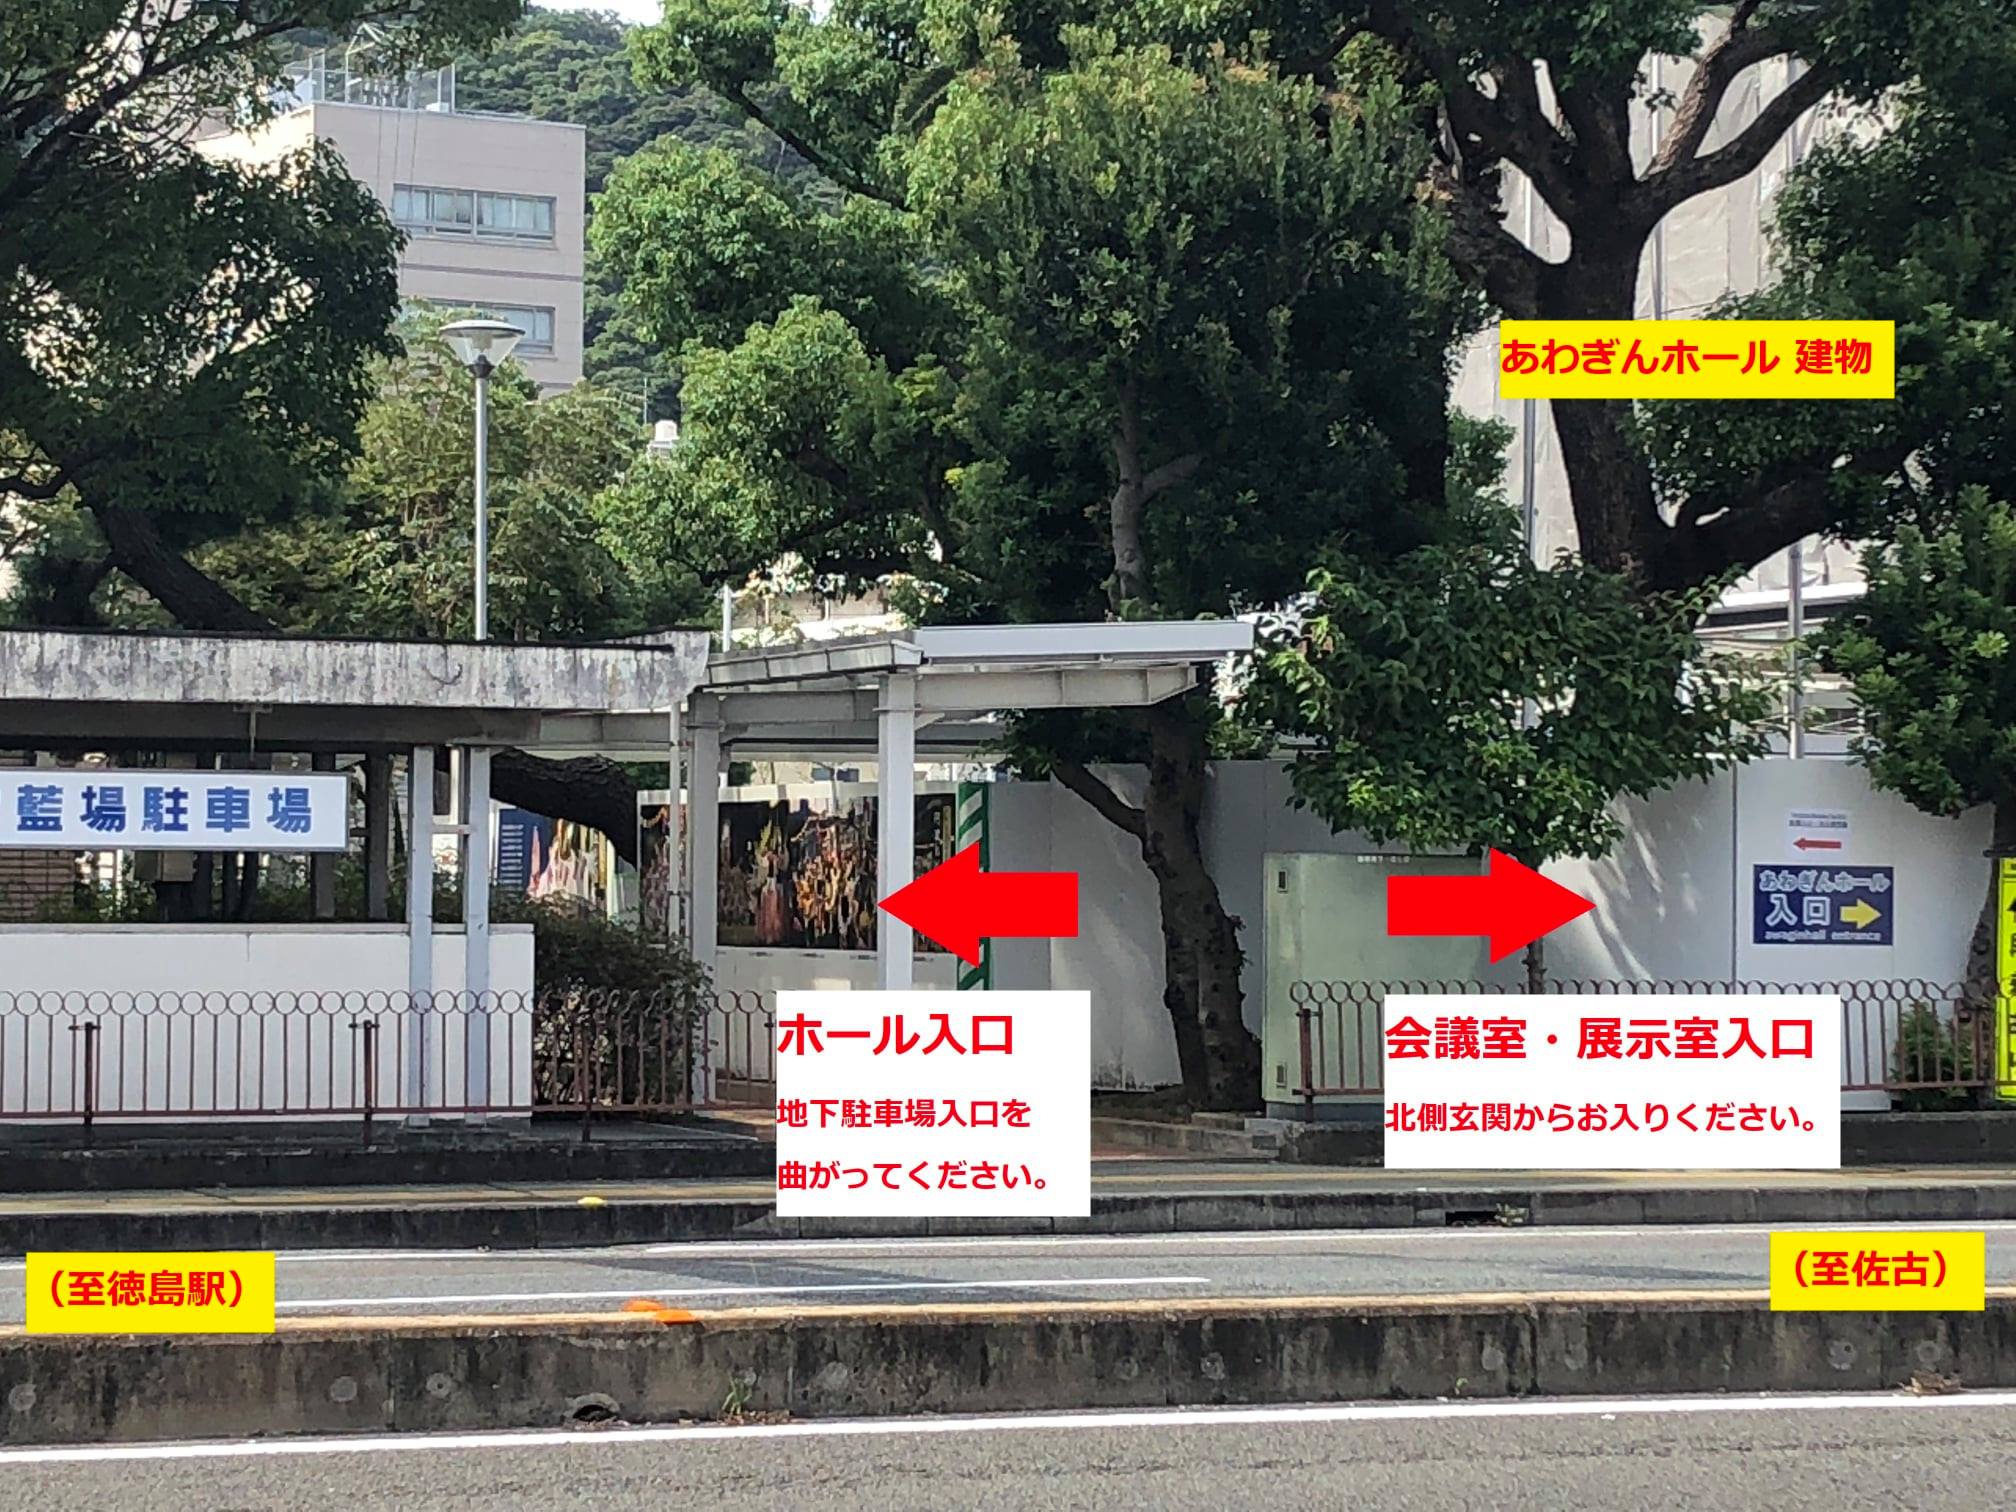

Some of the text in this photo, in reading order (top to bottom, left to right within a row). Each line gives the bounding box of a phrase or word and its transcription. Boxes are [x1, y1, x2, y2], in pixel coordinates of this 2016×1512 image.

[17, 784, 312, 833] 藍場駐車場
[1759, 869, 1891, 893] あわぎんホール
[1765, 893, 1831, 927] 入口
